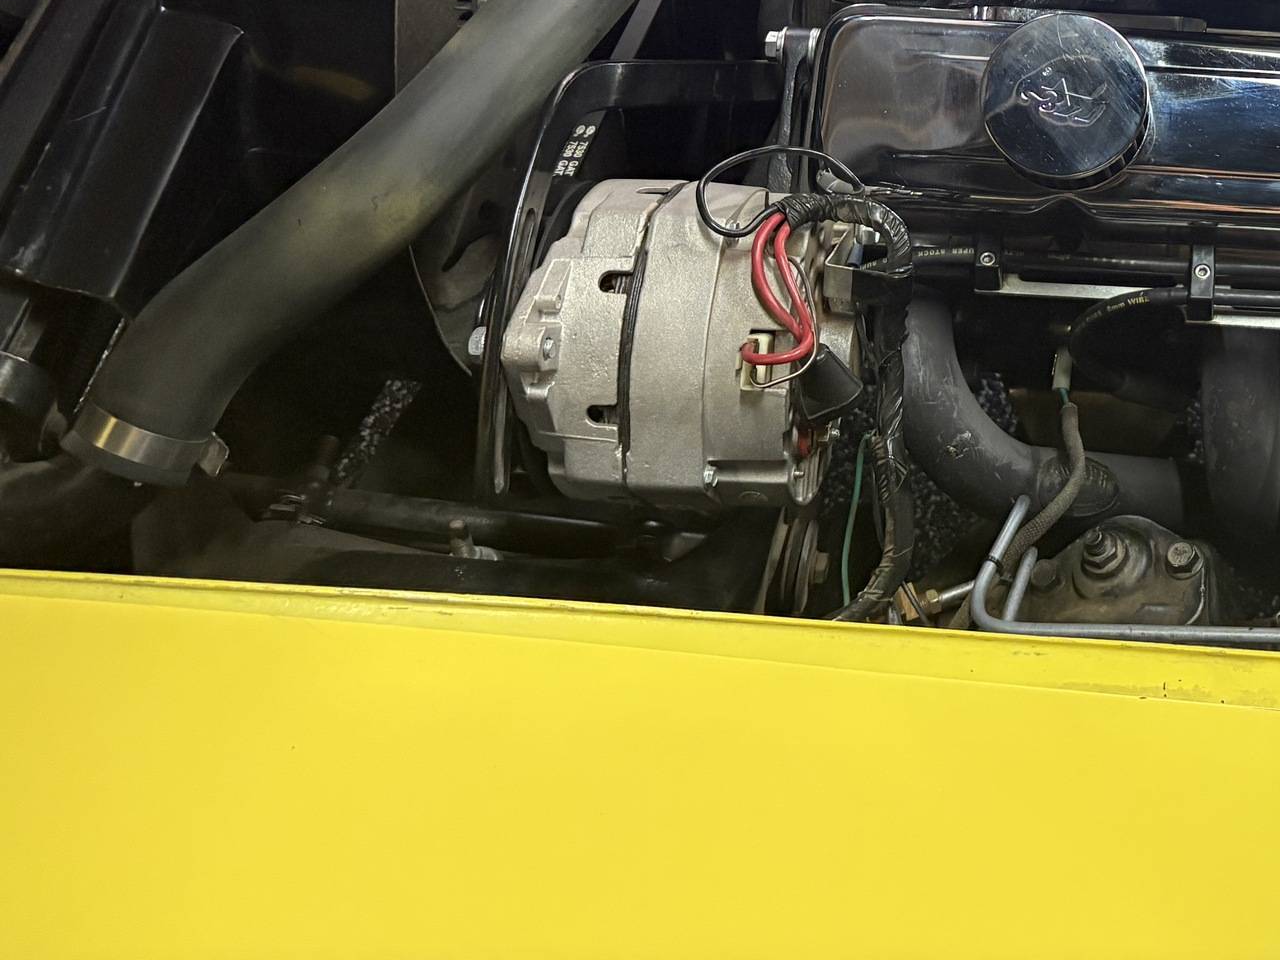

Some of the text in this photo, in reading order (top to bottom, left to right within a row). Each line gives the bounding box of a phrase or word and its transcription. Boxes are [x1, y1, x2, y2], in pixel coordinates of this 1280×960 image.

[553, 160, 568, 176] GAT
[917, 247, 975, 257] UPER STOCK
[1126, 294, 1151, 305] WIRE
